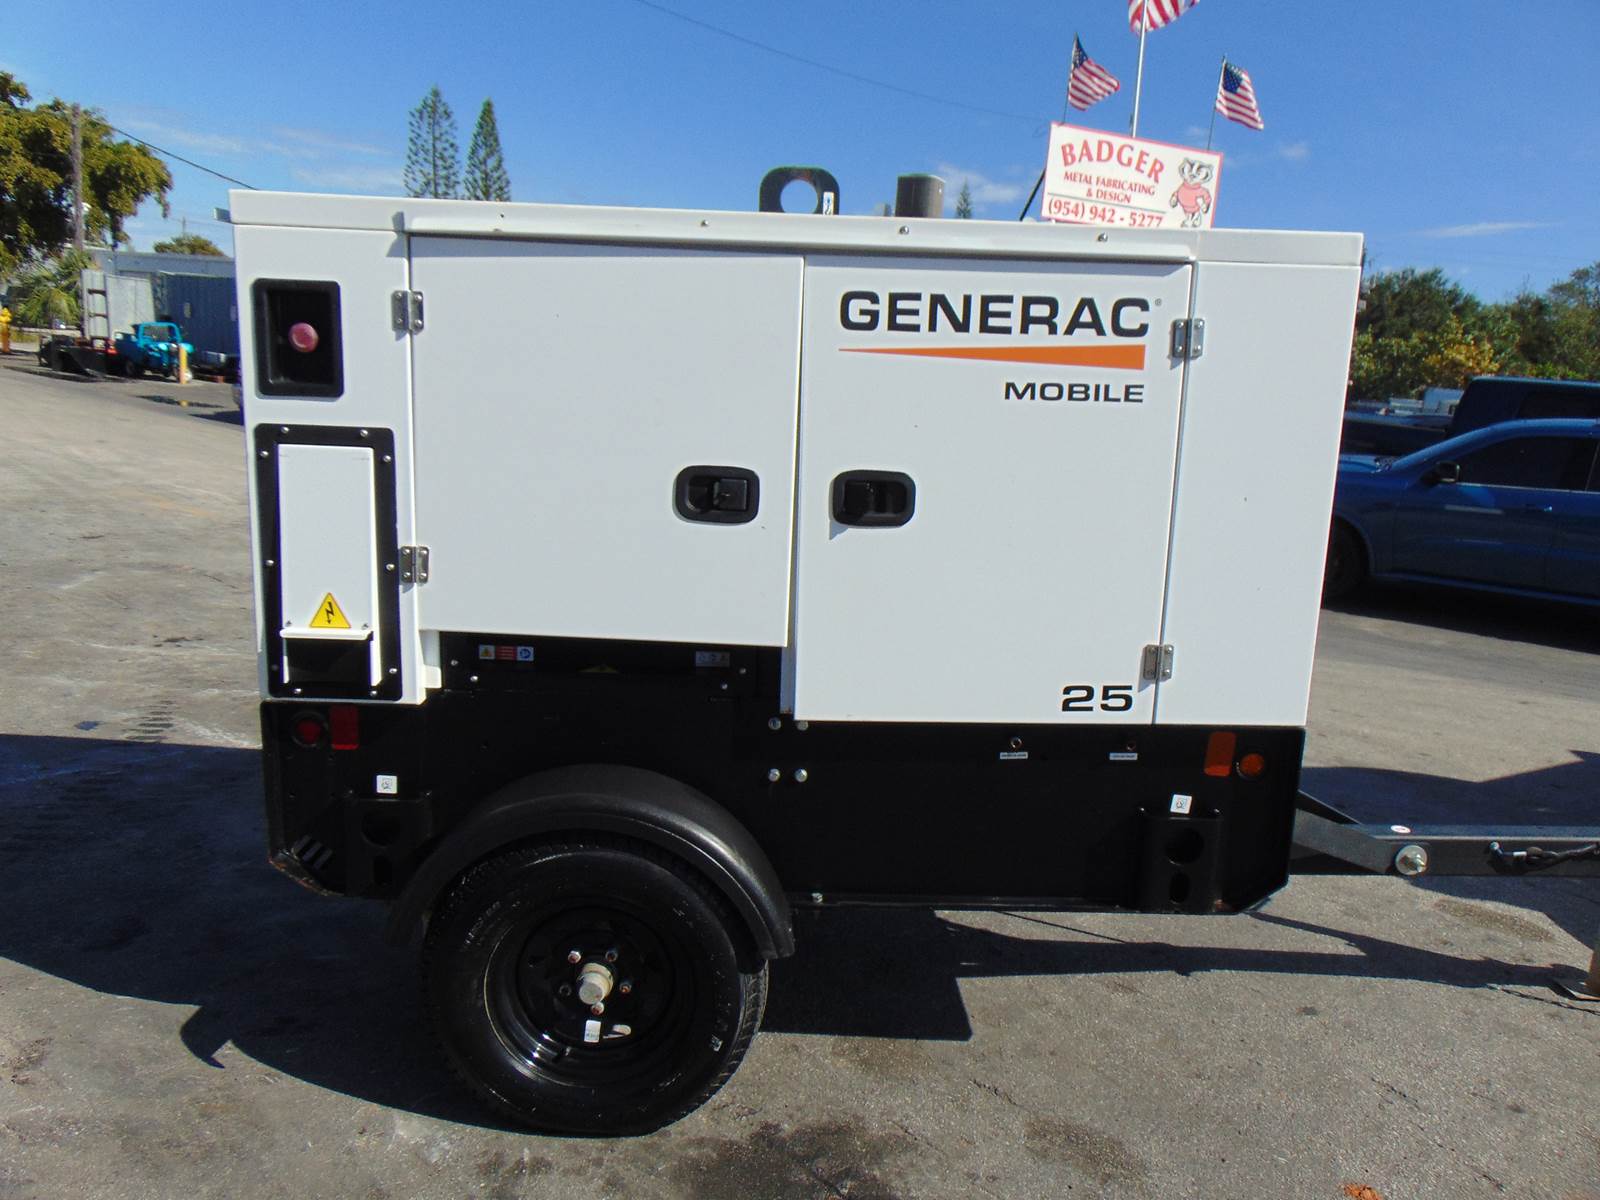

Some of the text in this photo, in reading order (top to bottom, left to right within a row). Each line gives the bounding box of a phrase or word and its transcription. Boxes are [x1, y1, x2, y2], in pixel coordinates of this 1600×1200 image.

[1061, 139, 1164, 183] BADGER
[1063, 171, 1156, 196] METAL FABRICATING
[1086, 188, 1131, 203] & DESIGN
[1048, 198, 1085, 219] (954)
[1089, 206, 1116, 223] 942
[1129, 213, 1163, 228] 5277
[839, 290, 1150, 338] GENERAC
[1004, 381, 1145, 403] MOBILE
[1061, 684, 1133, 712] 25
